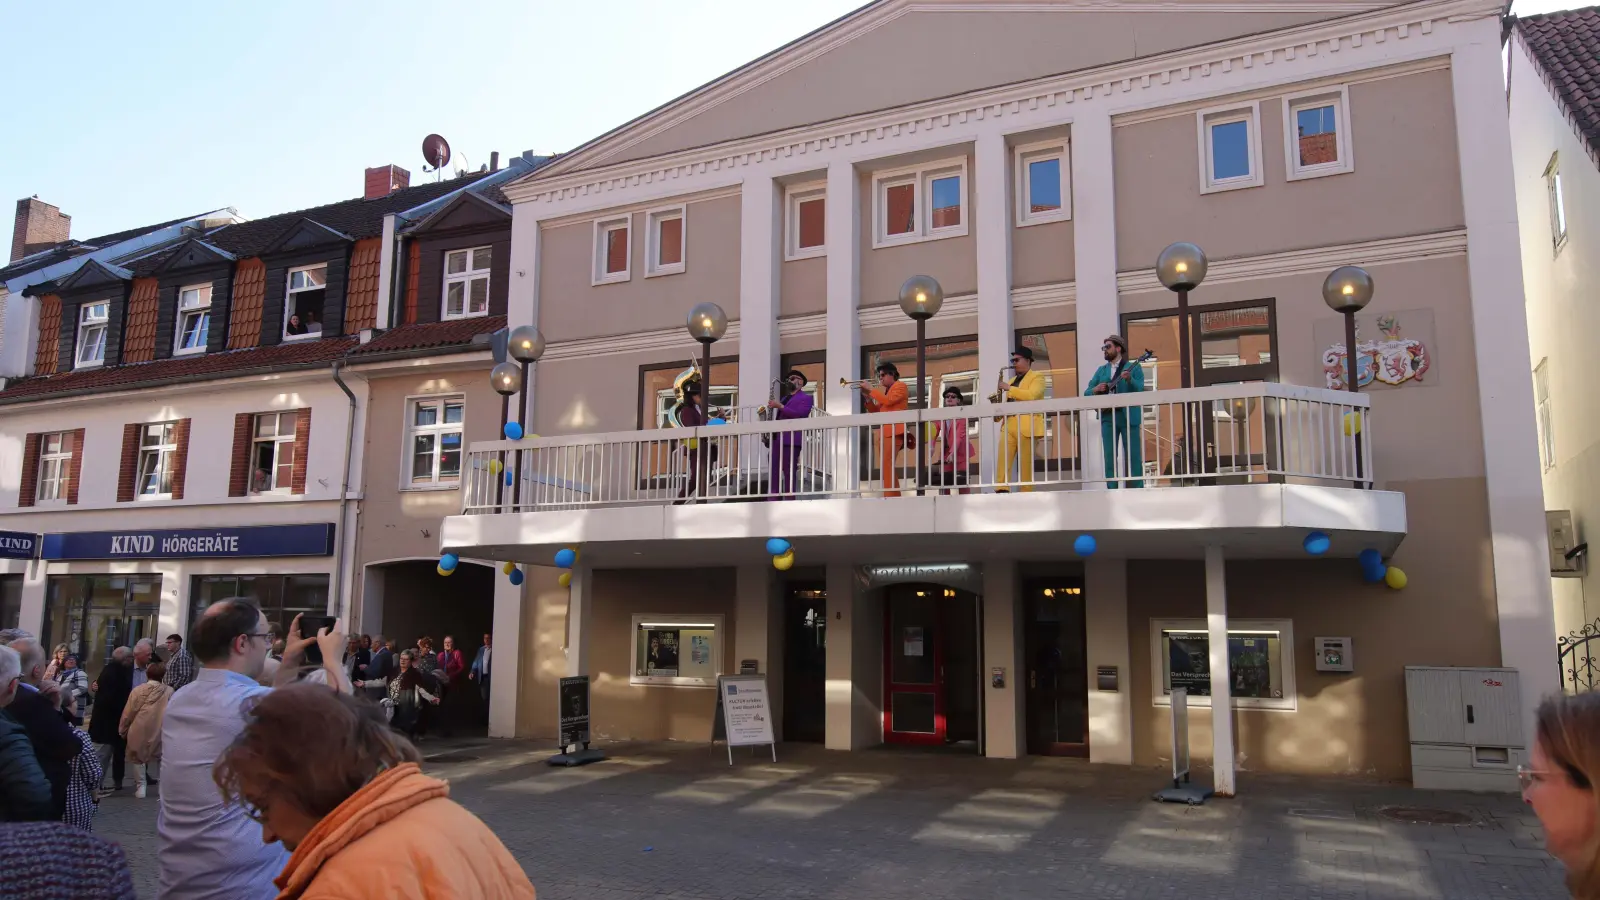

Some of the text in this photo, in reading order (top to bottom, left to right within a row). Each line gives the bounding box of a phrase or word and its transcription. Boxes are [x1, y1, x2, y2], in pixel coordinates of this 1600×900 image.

[110, 533, 238, 554] KIND HÖRGERÄTE
[863, 564, 969, 581] Stadttheater
